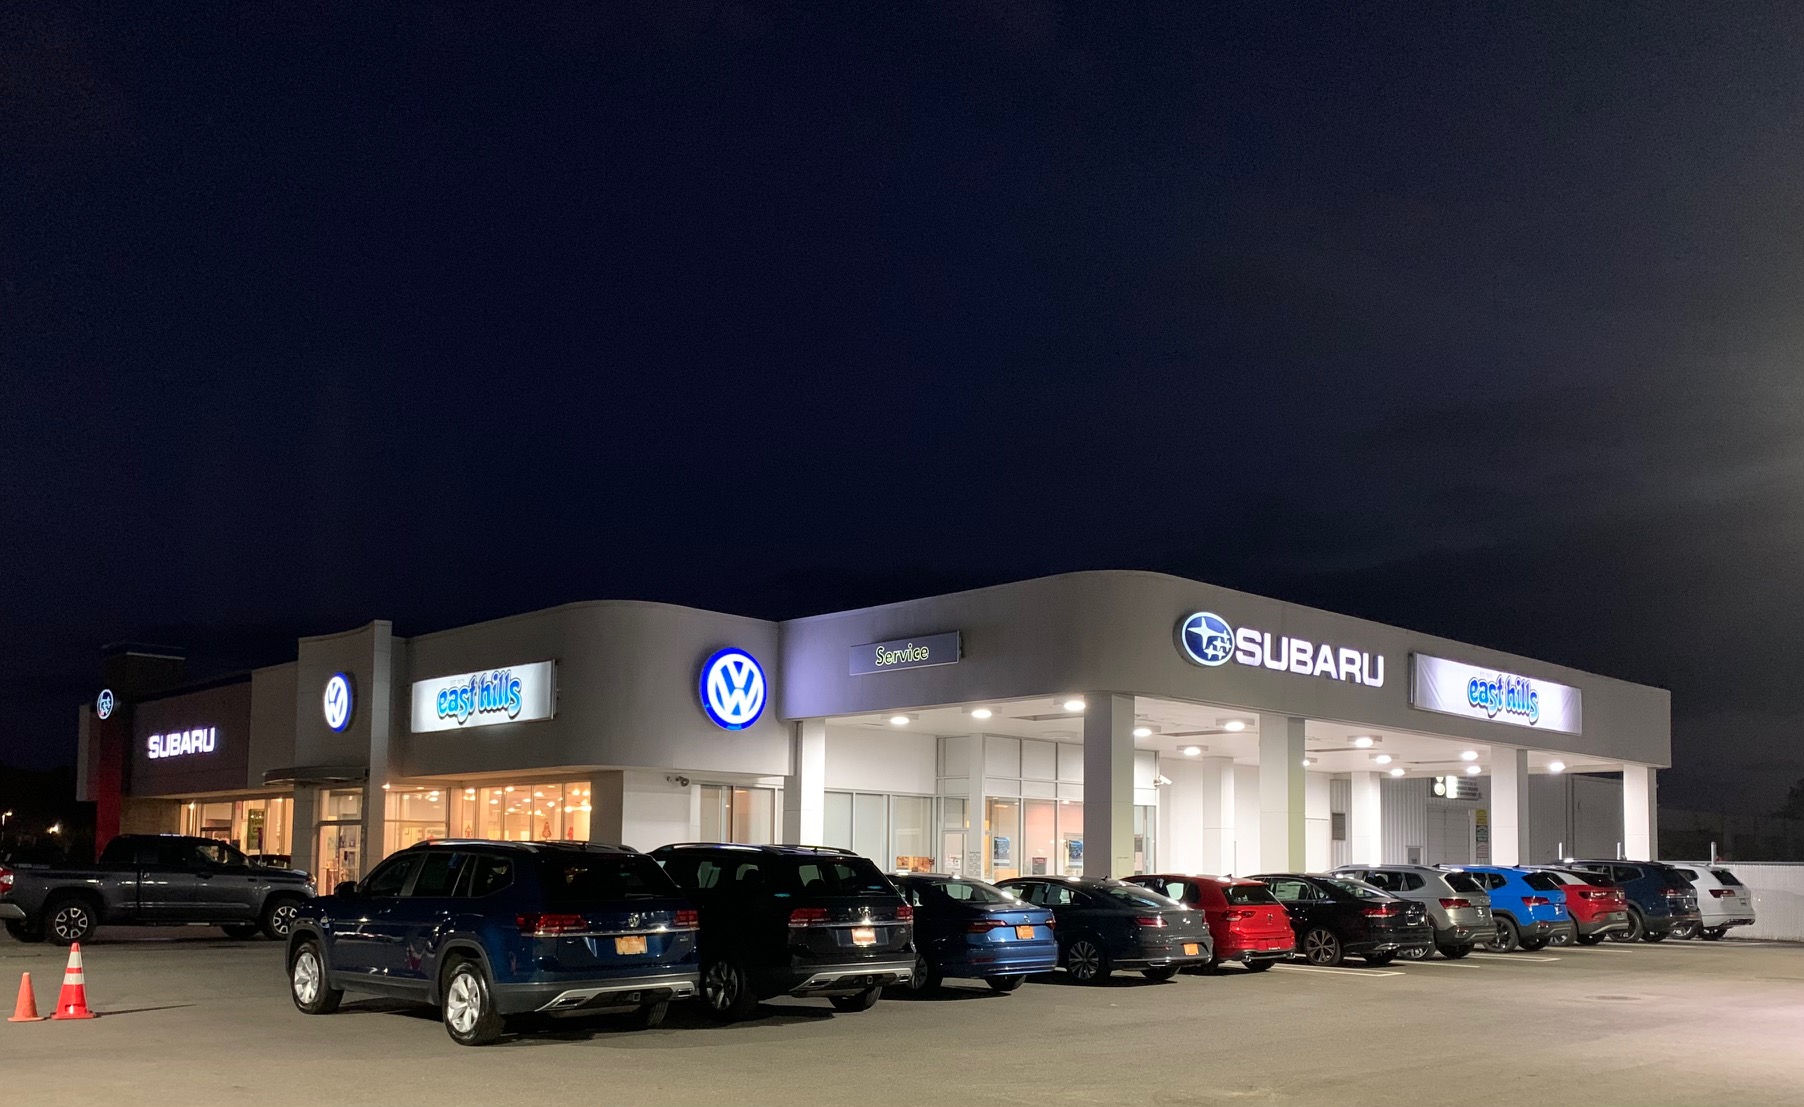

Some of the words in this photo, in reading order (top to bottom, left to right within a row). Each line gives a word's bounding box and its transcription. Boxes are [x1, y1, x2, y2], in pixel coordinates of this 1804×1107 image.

[875, 642, 929, 667] Service
[1236, 627, 1385, 688] SUBARU
[437, 674, 477, 725] east
[478, 669, 522, 719] hills
[1467, 674, 1504, 718] east
[1505, 675, 1539, 725] hills
[148, 727, 216, 759] SUBARU
